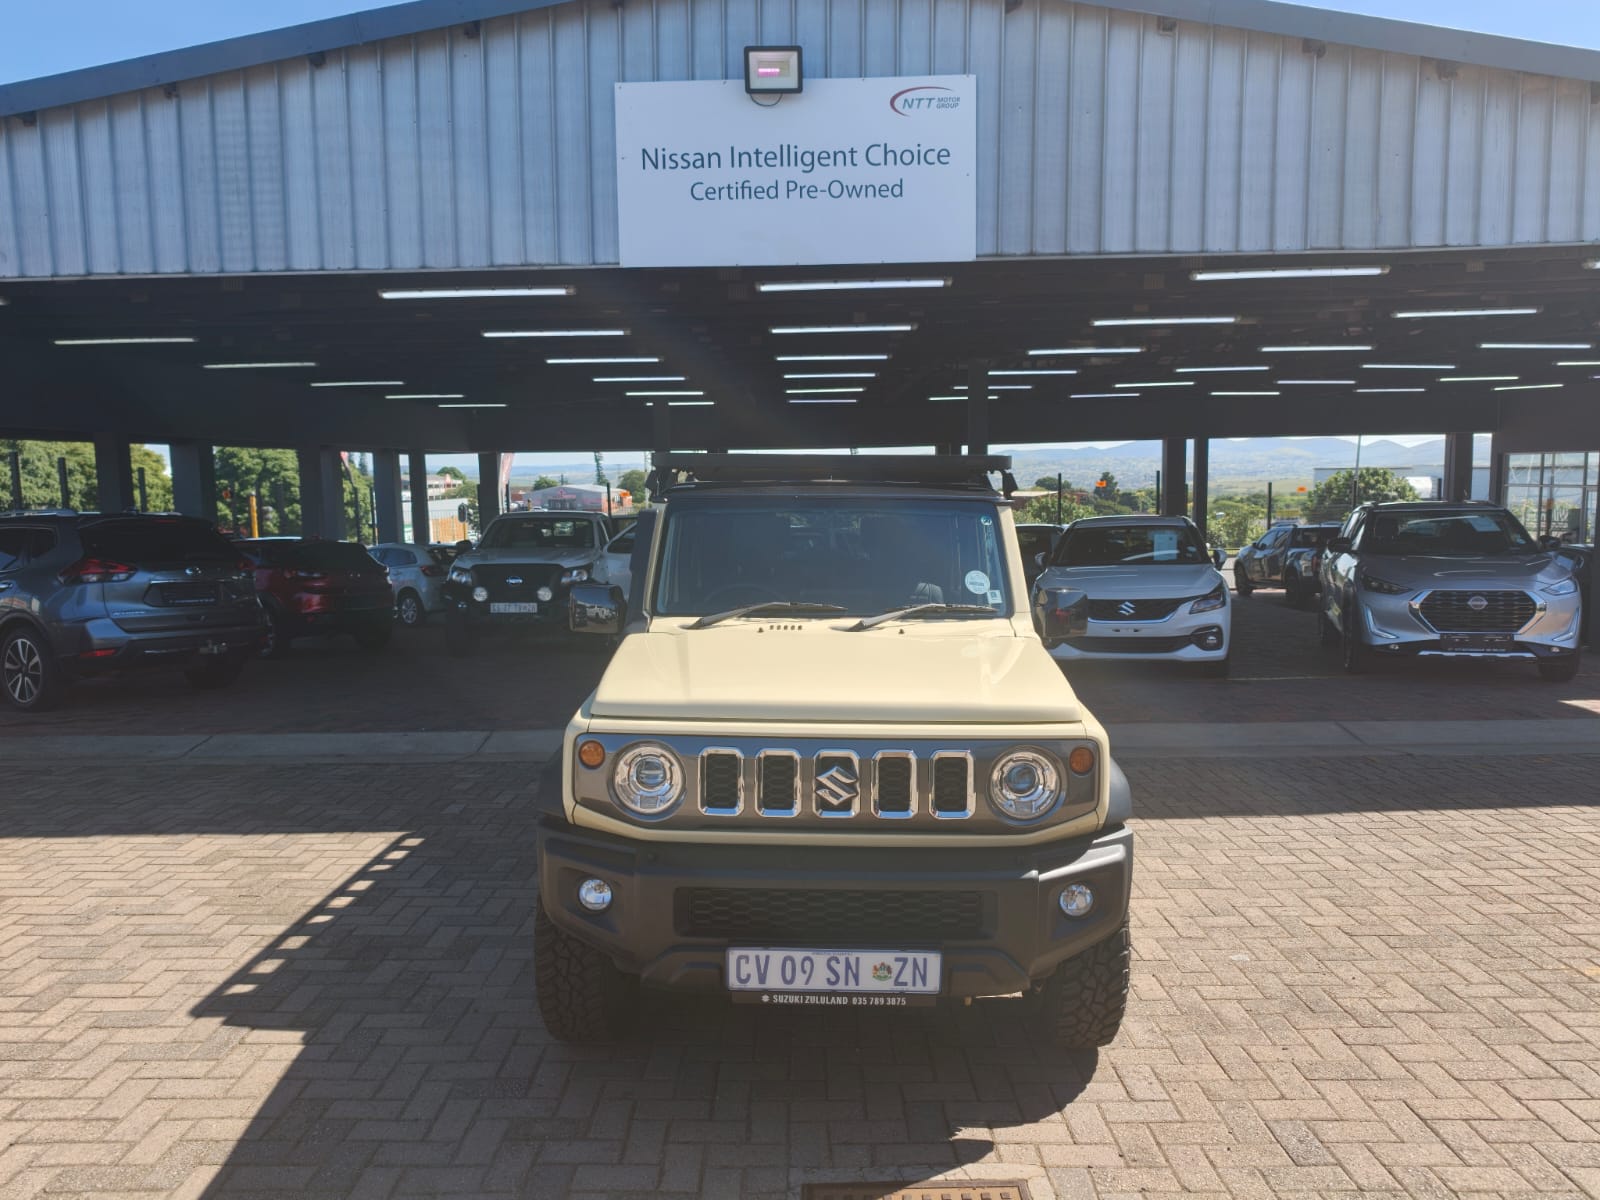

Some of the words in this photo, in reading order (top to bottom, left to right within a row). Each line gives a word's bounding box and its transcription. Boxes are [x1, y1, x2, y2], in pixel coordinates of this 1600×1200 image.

[903, 97, 935, 109] NTT
[641, 147, 721, 170] Nissan
[730, 144, 857, 173] Intelligent
[865, 143, 950, 167] Choice
[690, 180, 779, 201] Certified
[786, 178, 903, 199] Pre-Owned
[735, 954, 770, 985] CV
[781, 955, 815, 986] 09
[826, 956, 860, 987] SN
[893, 957, 927, 987] ZN
[772, 994, 803, 1003] SUZUKI
[804, 995, 848, 1005] ZULULAND
[852, 997, 867, 1005] 035
[869, 997, 885, 1005] 789
